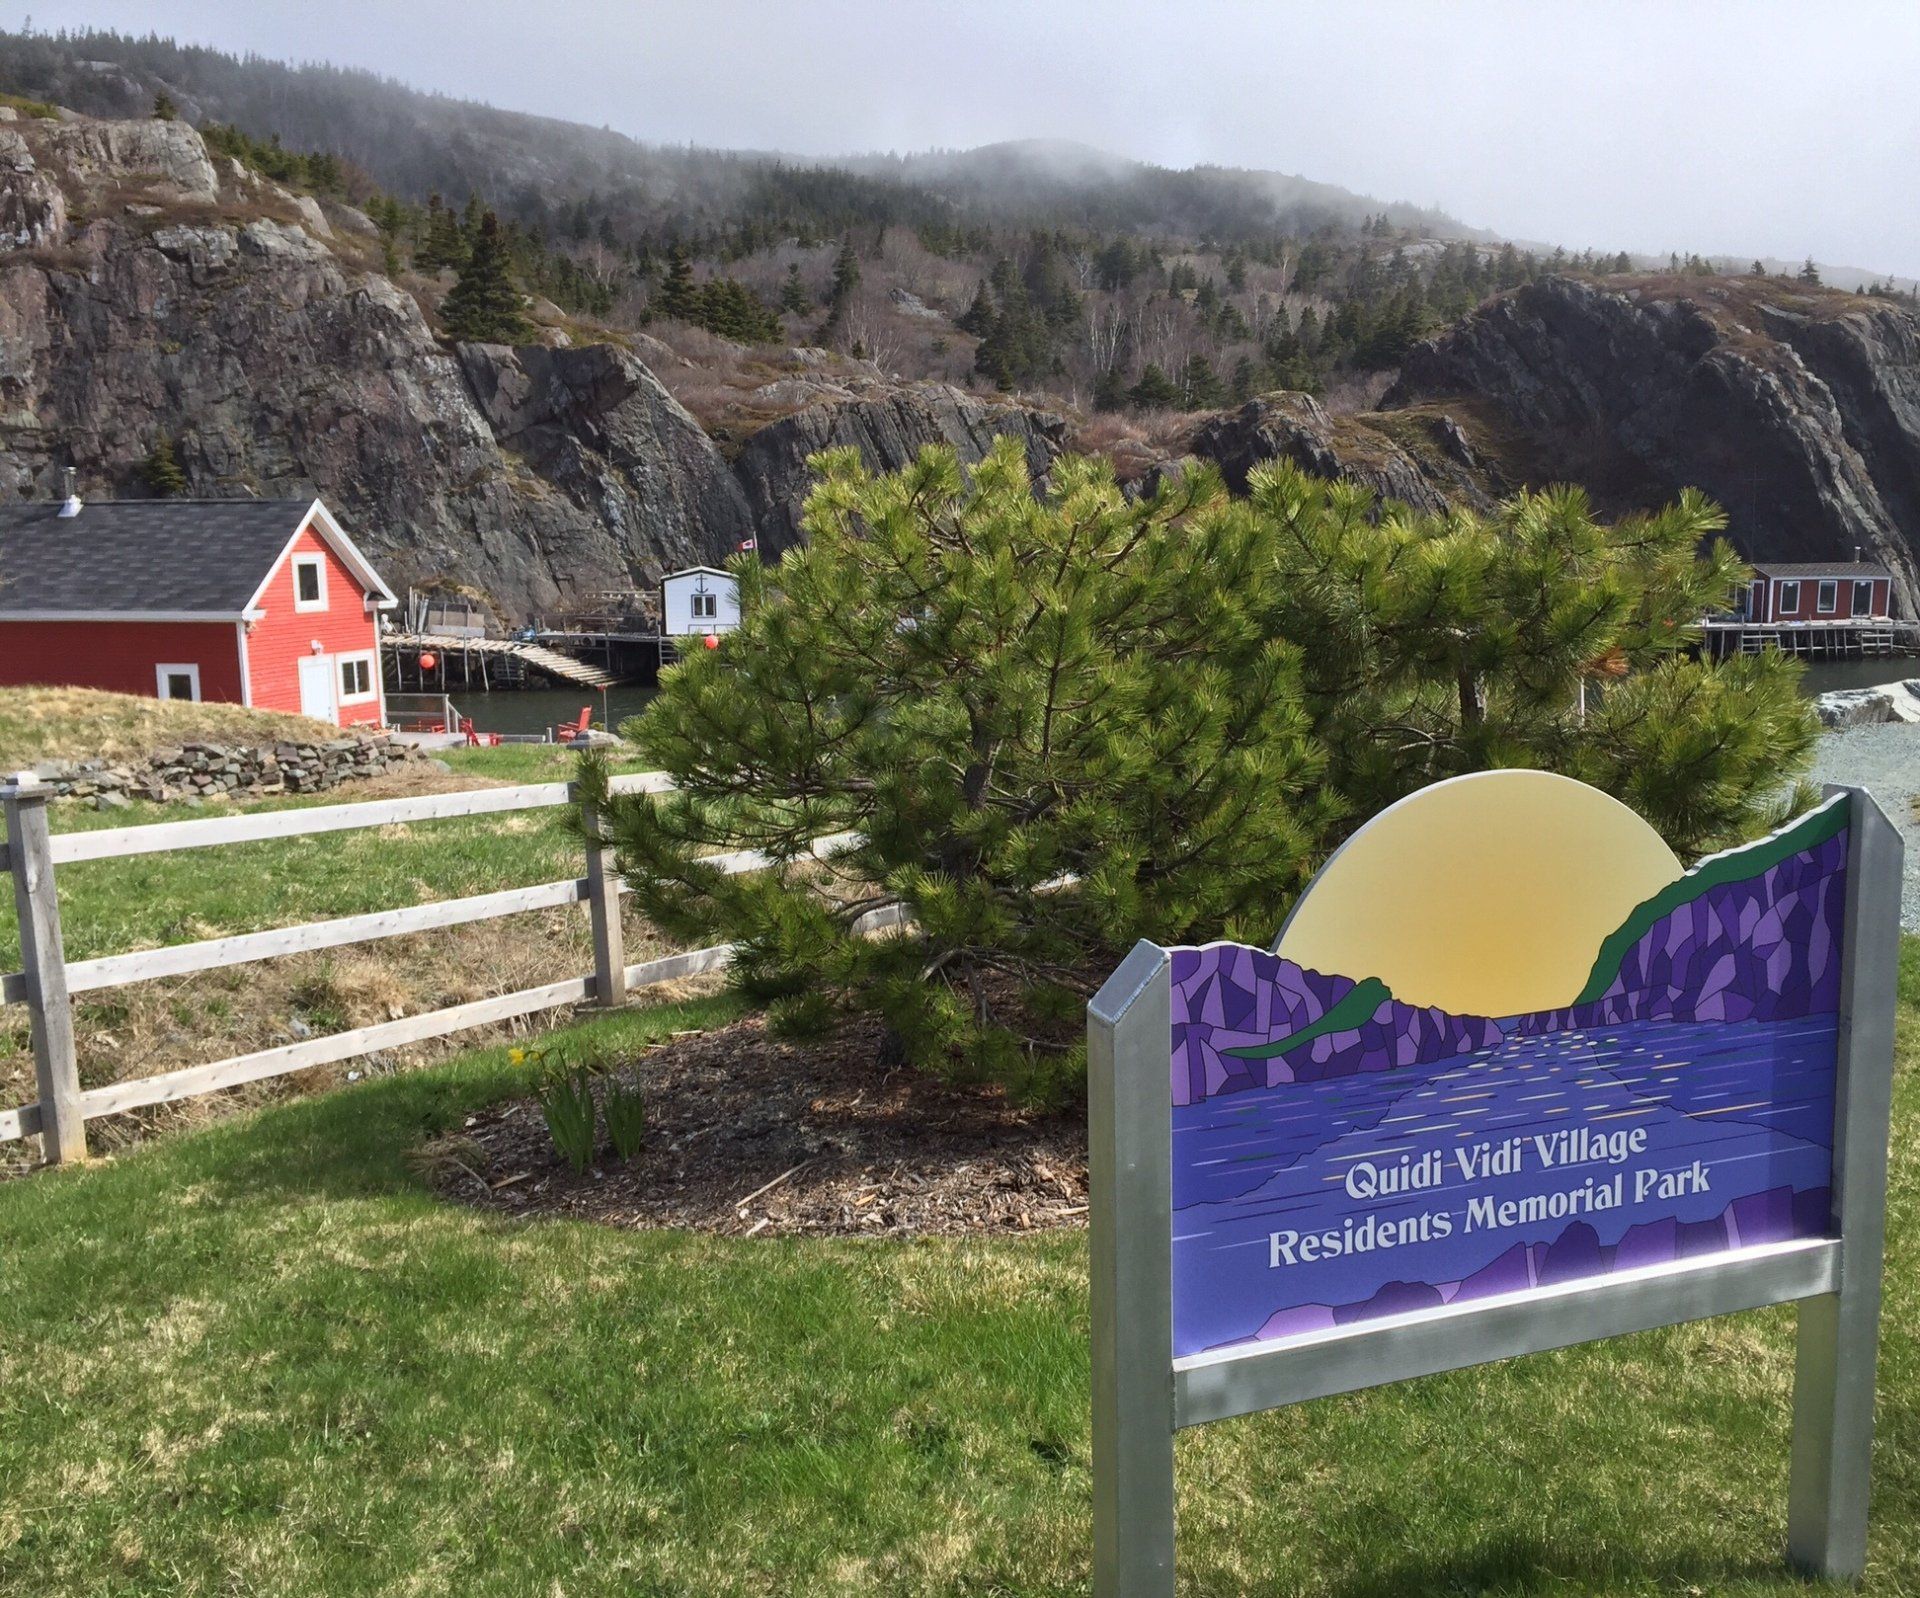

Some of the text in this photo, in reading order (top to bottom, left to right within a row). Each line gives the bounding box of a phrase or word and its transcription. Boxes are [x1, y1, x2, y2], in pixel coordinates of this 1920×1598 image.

[1345, 1126, 1648, 1199] Quidi Vidi Village
[1268, 1160, 1711, 1268] Residents Memorial Park
